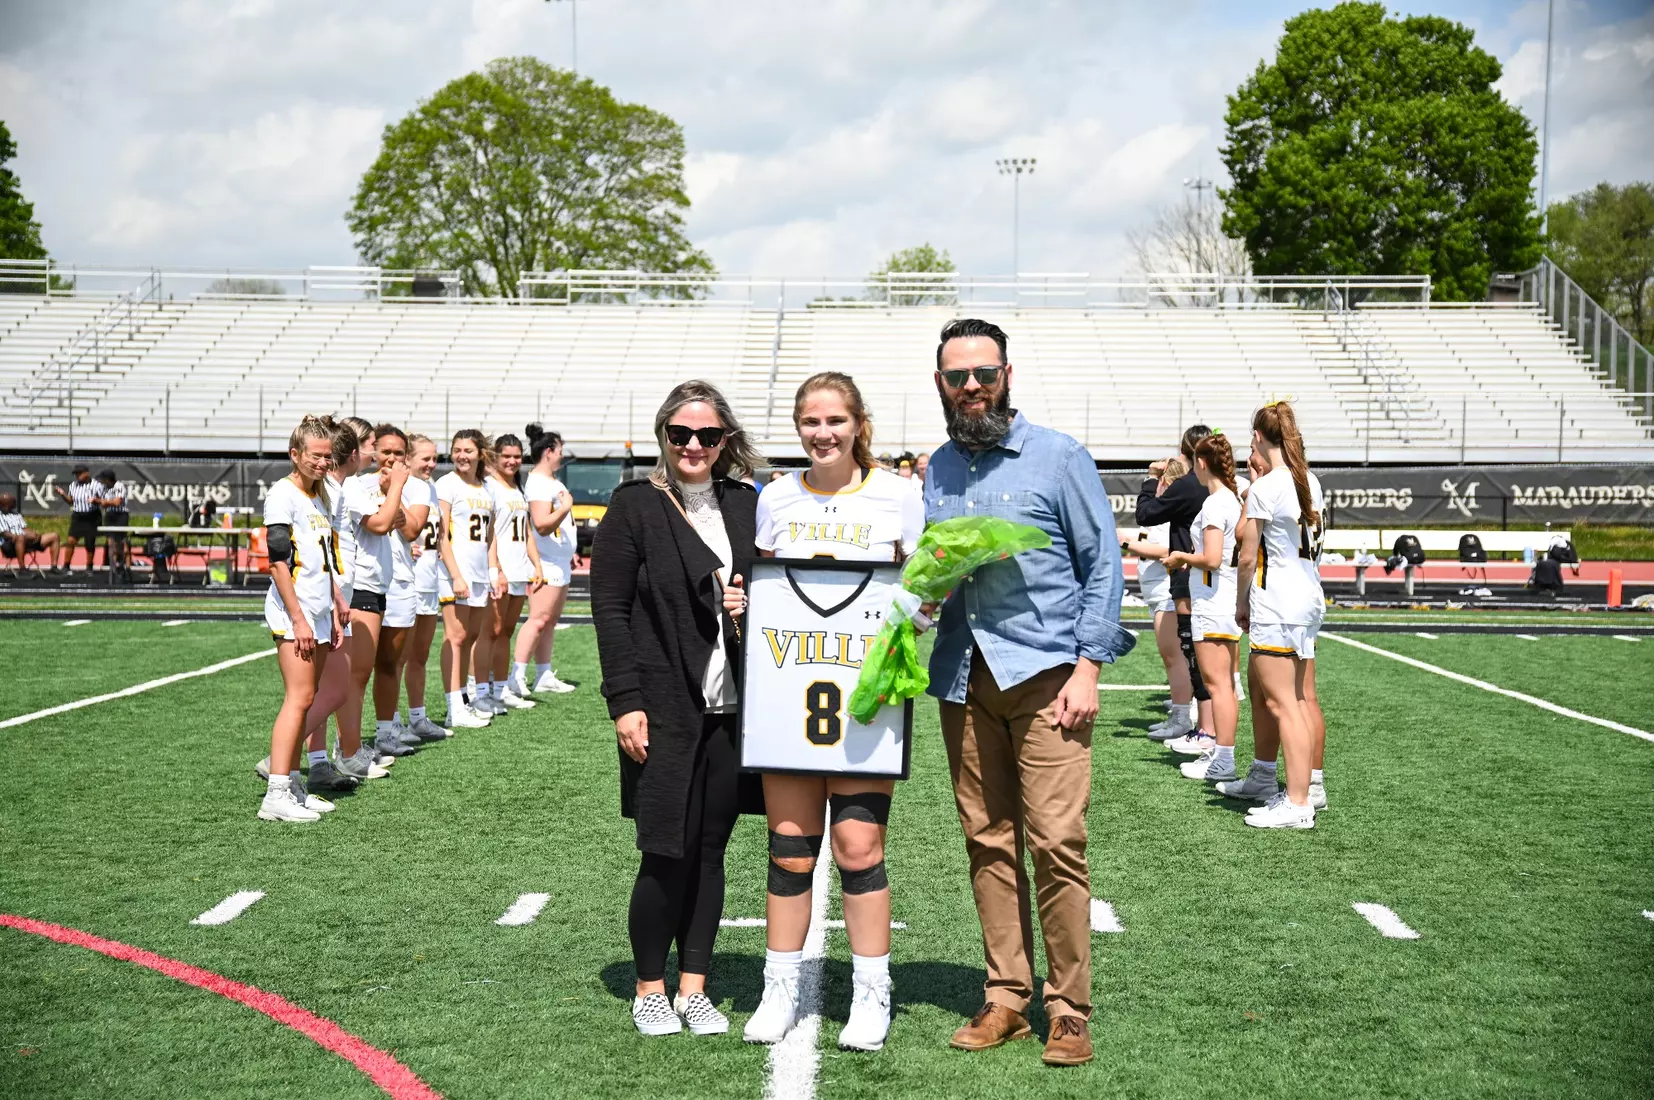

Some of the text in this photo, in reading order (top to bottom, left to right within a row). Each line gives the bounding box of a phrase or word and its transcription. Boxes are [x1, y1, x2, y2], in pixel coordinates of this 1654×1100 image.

[121, 480, 232, 504] RAUDERS
[788, 521, 872, 549] VILLE
[804, 679, 844, 747] 8
